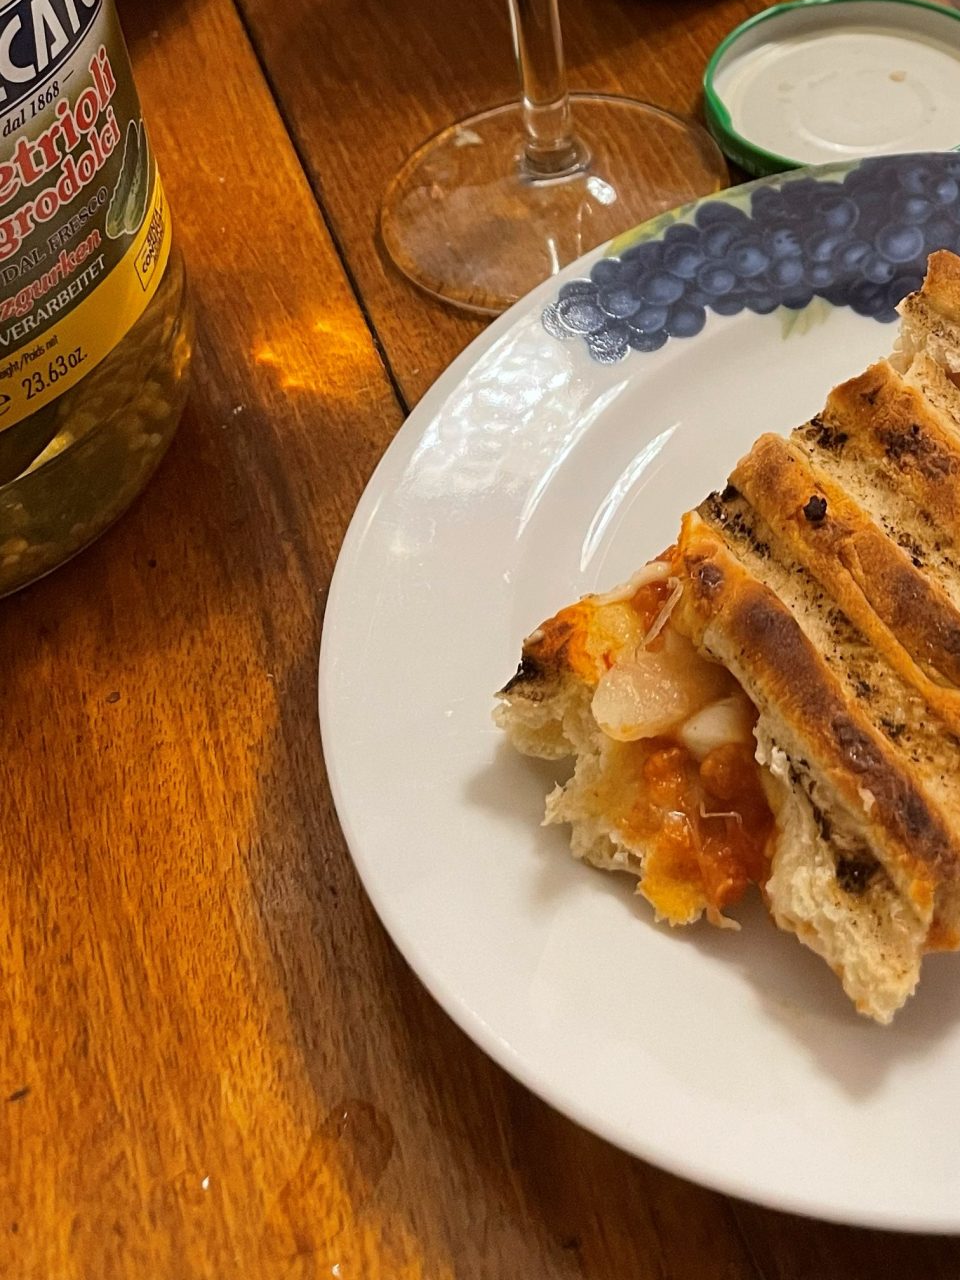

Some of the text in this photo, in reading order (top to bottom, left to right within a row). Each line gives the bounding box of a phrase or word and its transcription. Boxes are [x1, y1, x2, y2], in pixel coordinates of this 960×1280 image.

[3, 81, 60, 137] dal 1868
[1, 248, 46, 285] DAL
[47, 186, 108, 254] FRESCO
[0, 253, 104, 346] VERARBEITET
[21, 355, 68, 400] 23.63
[68, 346, 88, 368] oz.
